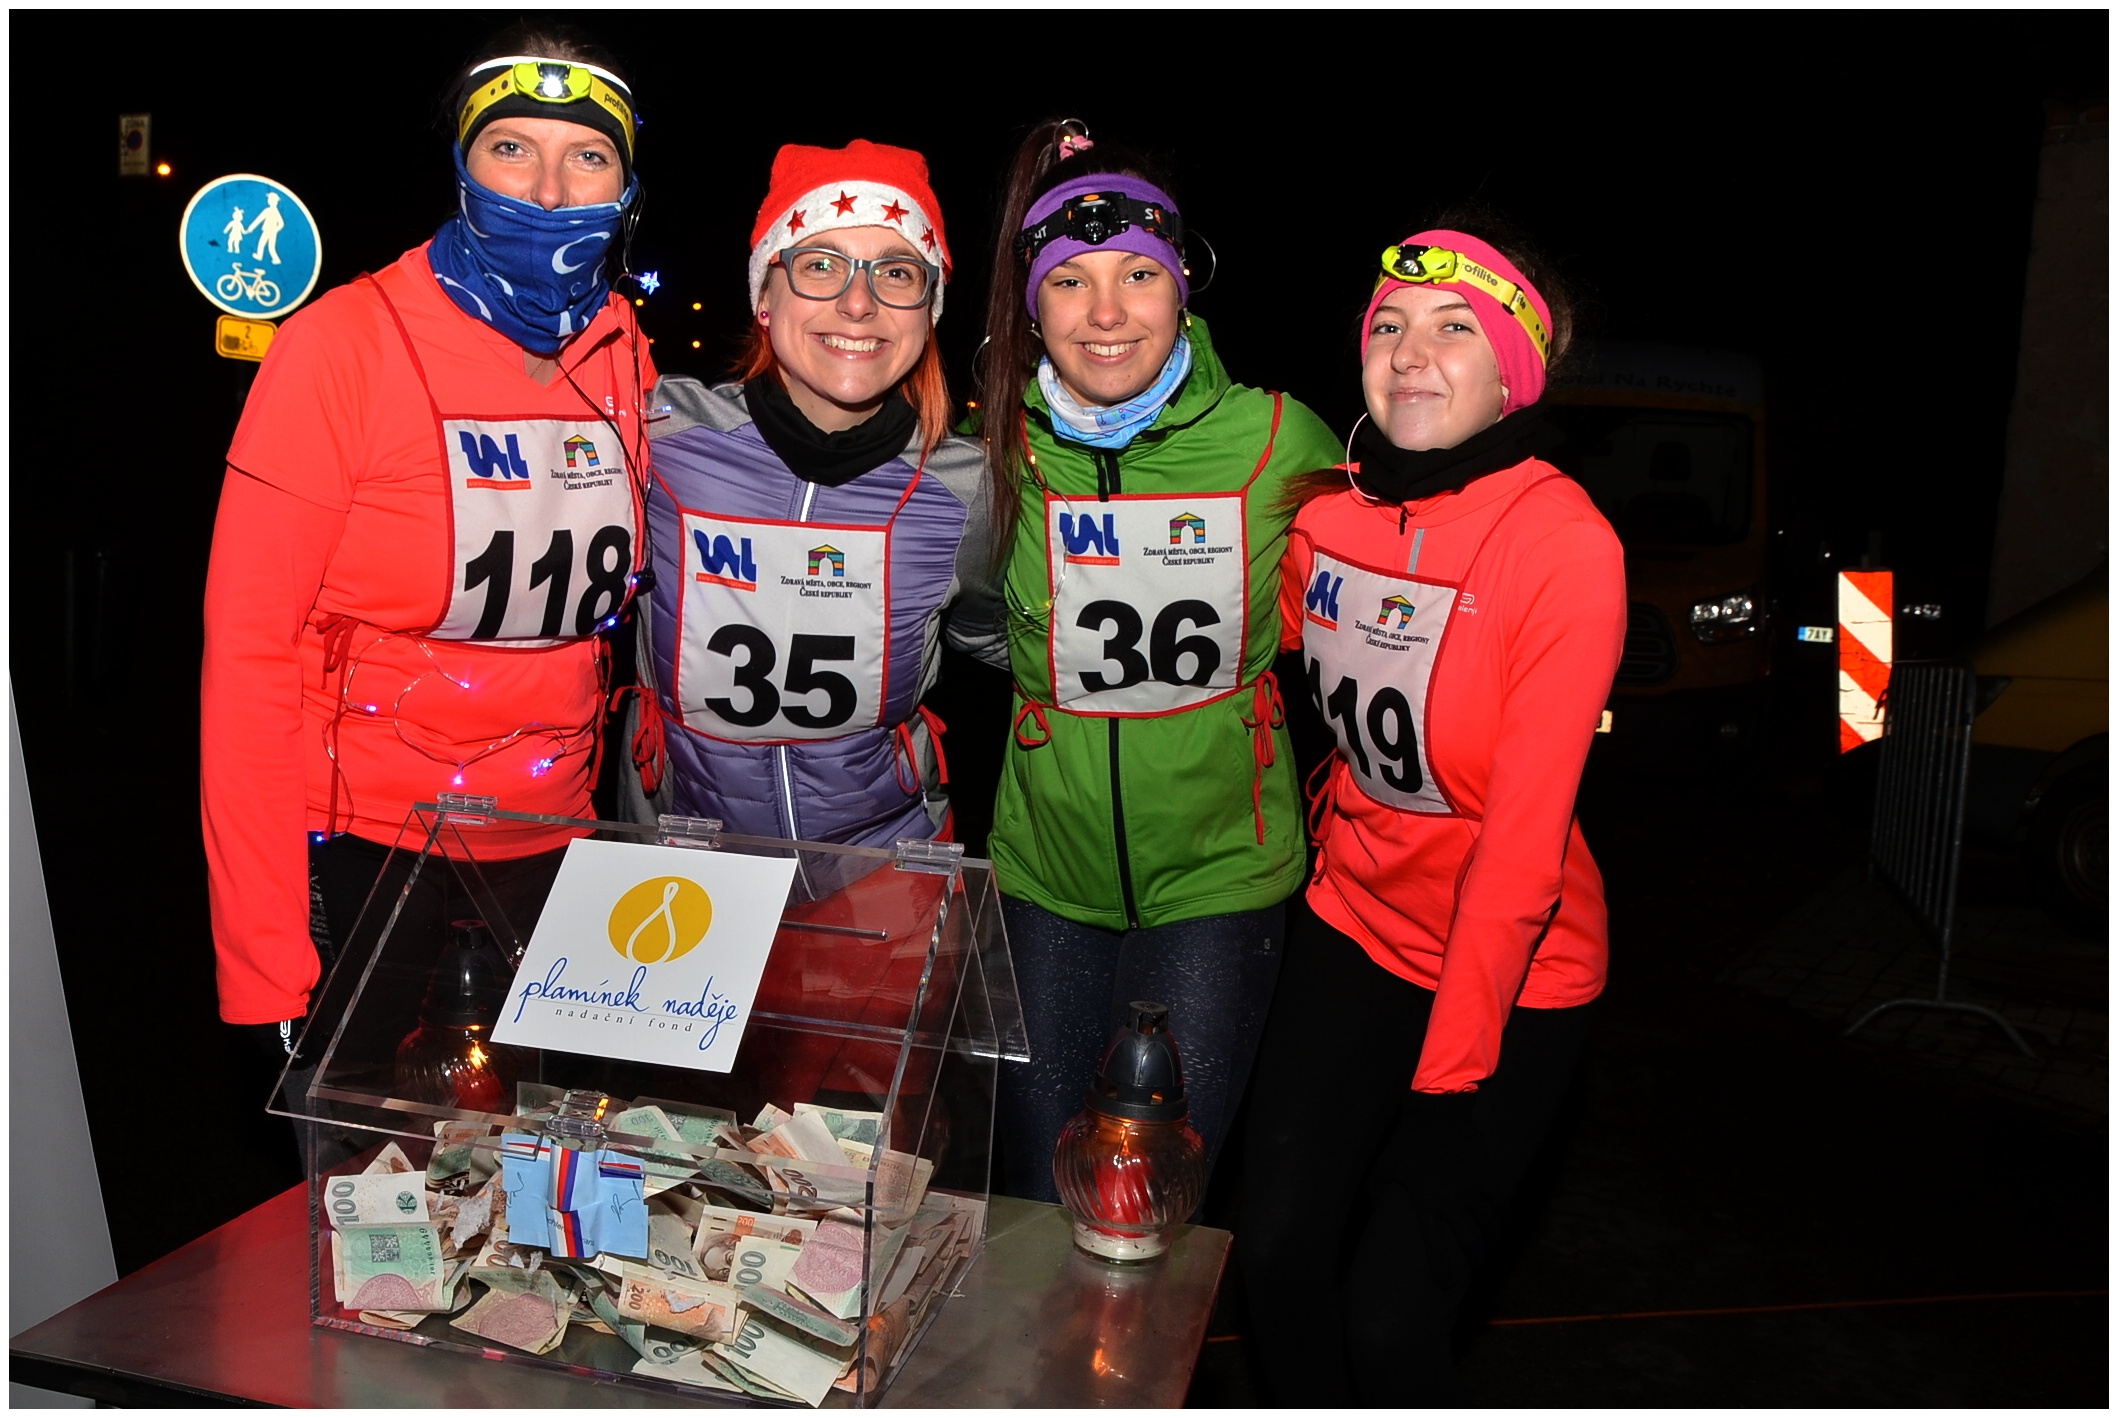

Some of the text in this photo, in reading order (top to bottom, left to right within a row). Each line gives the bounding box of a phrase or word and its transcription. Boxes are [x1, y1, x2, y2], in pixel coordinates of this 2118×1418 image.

[1462, 263, 1499, 287] ofilite
[563, 479, 613, 491] ČESKÉ REPUBLIKY
[586, 469, 604, 479] OBCE,
[1143, 546, 1233, 557] ZDRAVÁ MĚSTA, OBCE, REGIONY
[1162, 555, 1215, 566] ČESKÉ REPUBLIKY
[464, 525, 631, 638] 118
[780, 575, 872, 590] ZDRAVÁ MĚSTA, OBCE, REGIONY
[799, 586, 853, 599] ČESKÉ REPUBLIKY
[1076, 599, 1221, 693] 36
[1403, 634, 1430, 646] REGIONY
[704, 623, 858, 729] 35
[515, 957, 738, 1051] plamínek naděje
[555, 1005, 693, 1032] nadační fond
[654, 1248, 699, 1276] 100
[734, 1250, 767, 1290] 00
[628, 1283, 645, 1311] 200
[724, 1324, 765, 1360] 100
